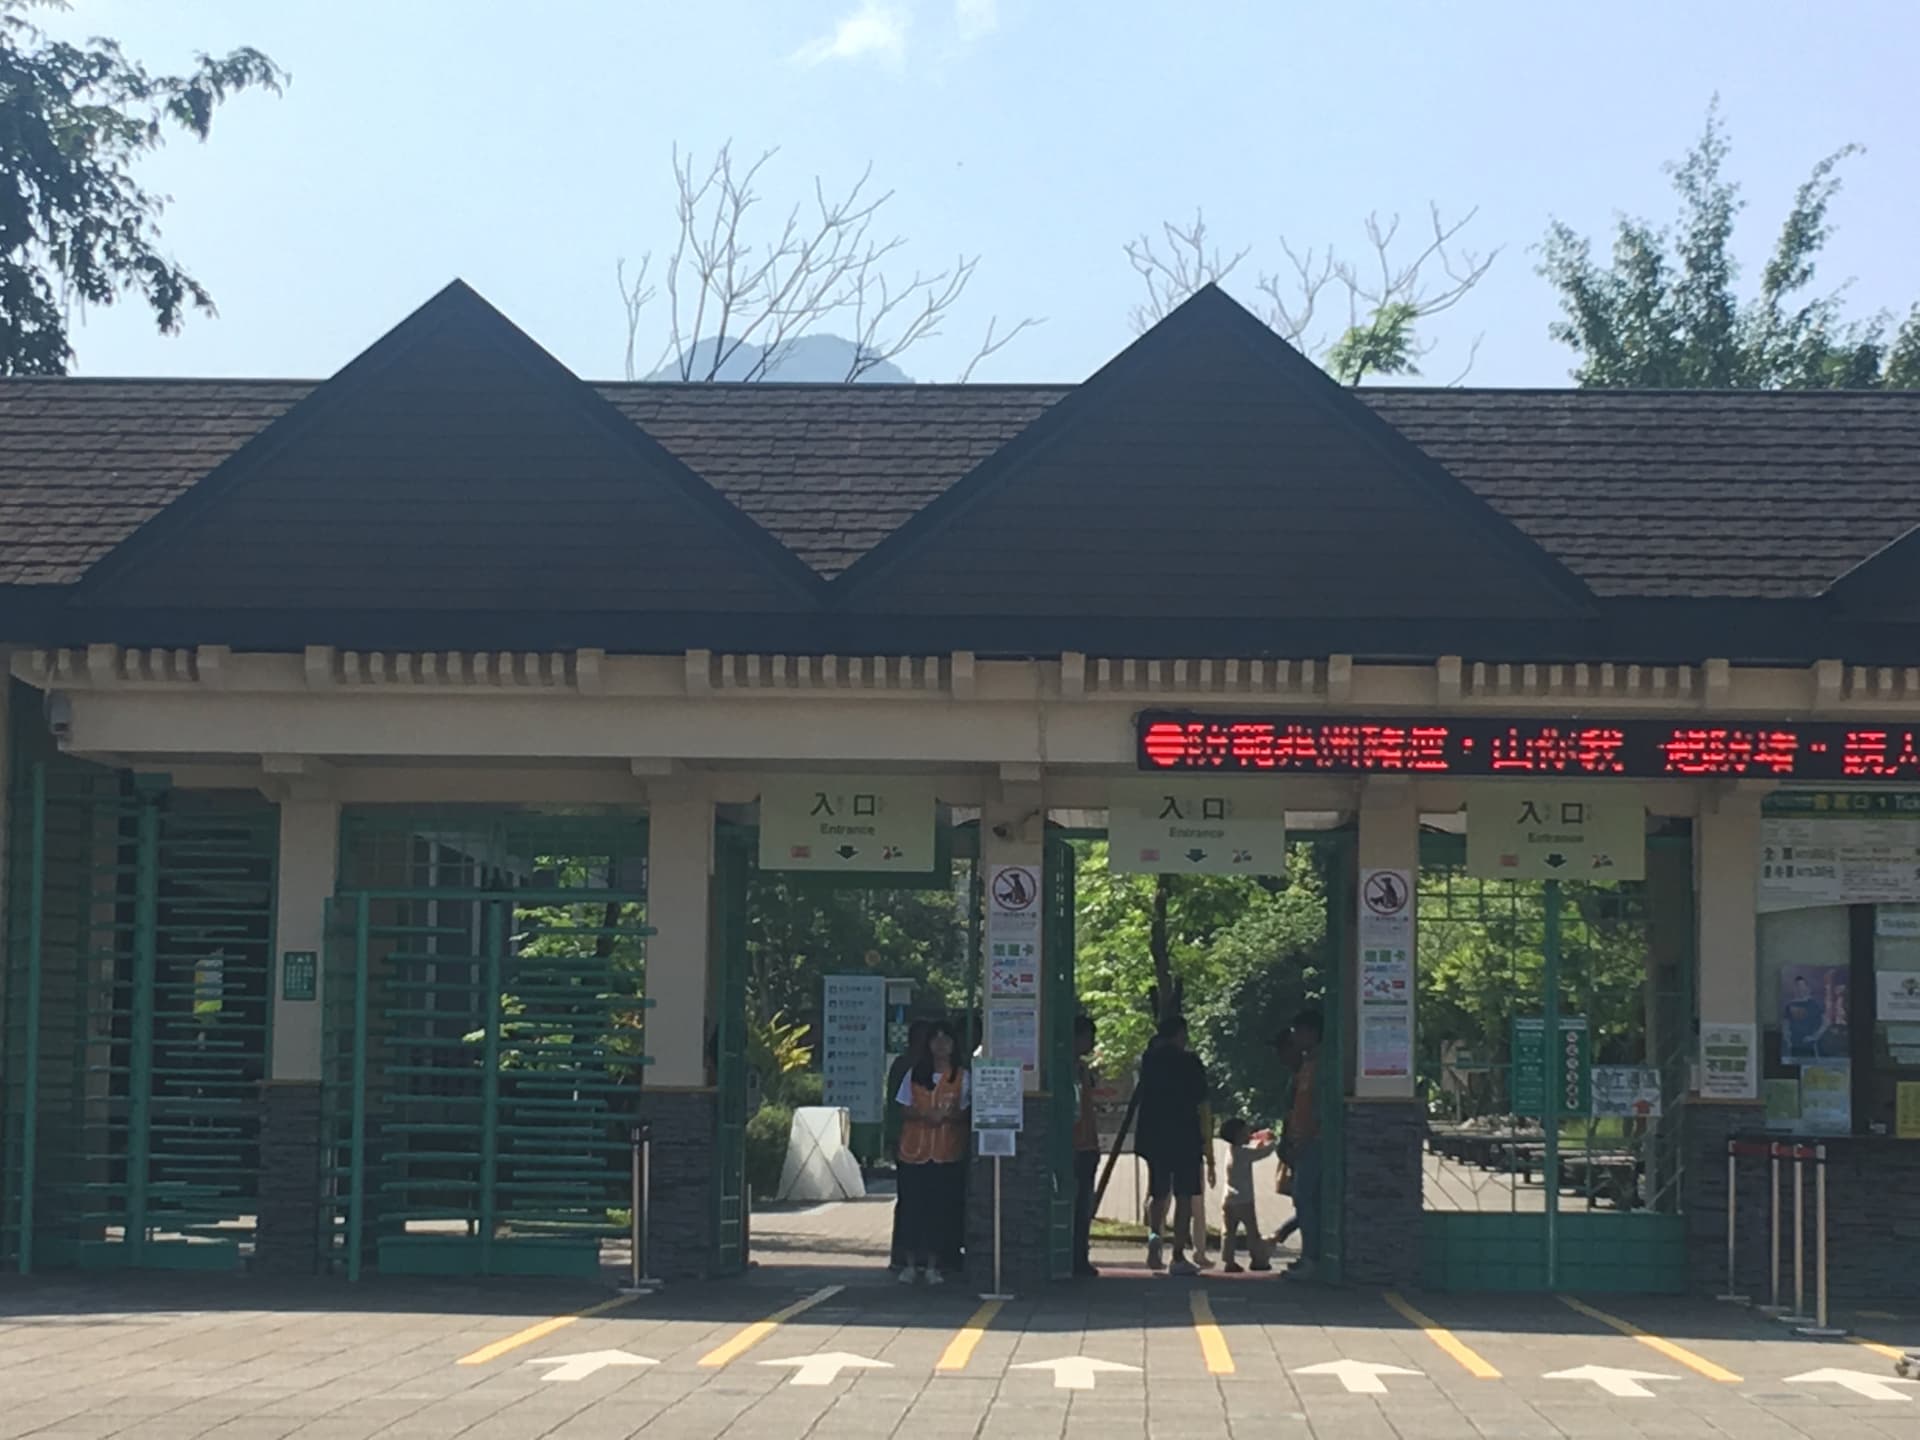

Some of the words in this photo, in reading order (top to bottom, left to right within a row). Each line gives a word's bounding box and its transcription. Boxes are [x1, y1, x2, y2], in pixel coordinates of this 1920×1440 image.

[810, 792, 875, 816] 入口
[1159, 796, 1224, 819] 入口
[1517, 801, 1583, 824] 入口
[820, 823, 875, 835] Entrance
[1169, 827, 1225, 838] Entrance
